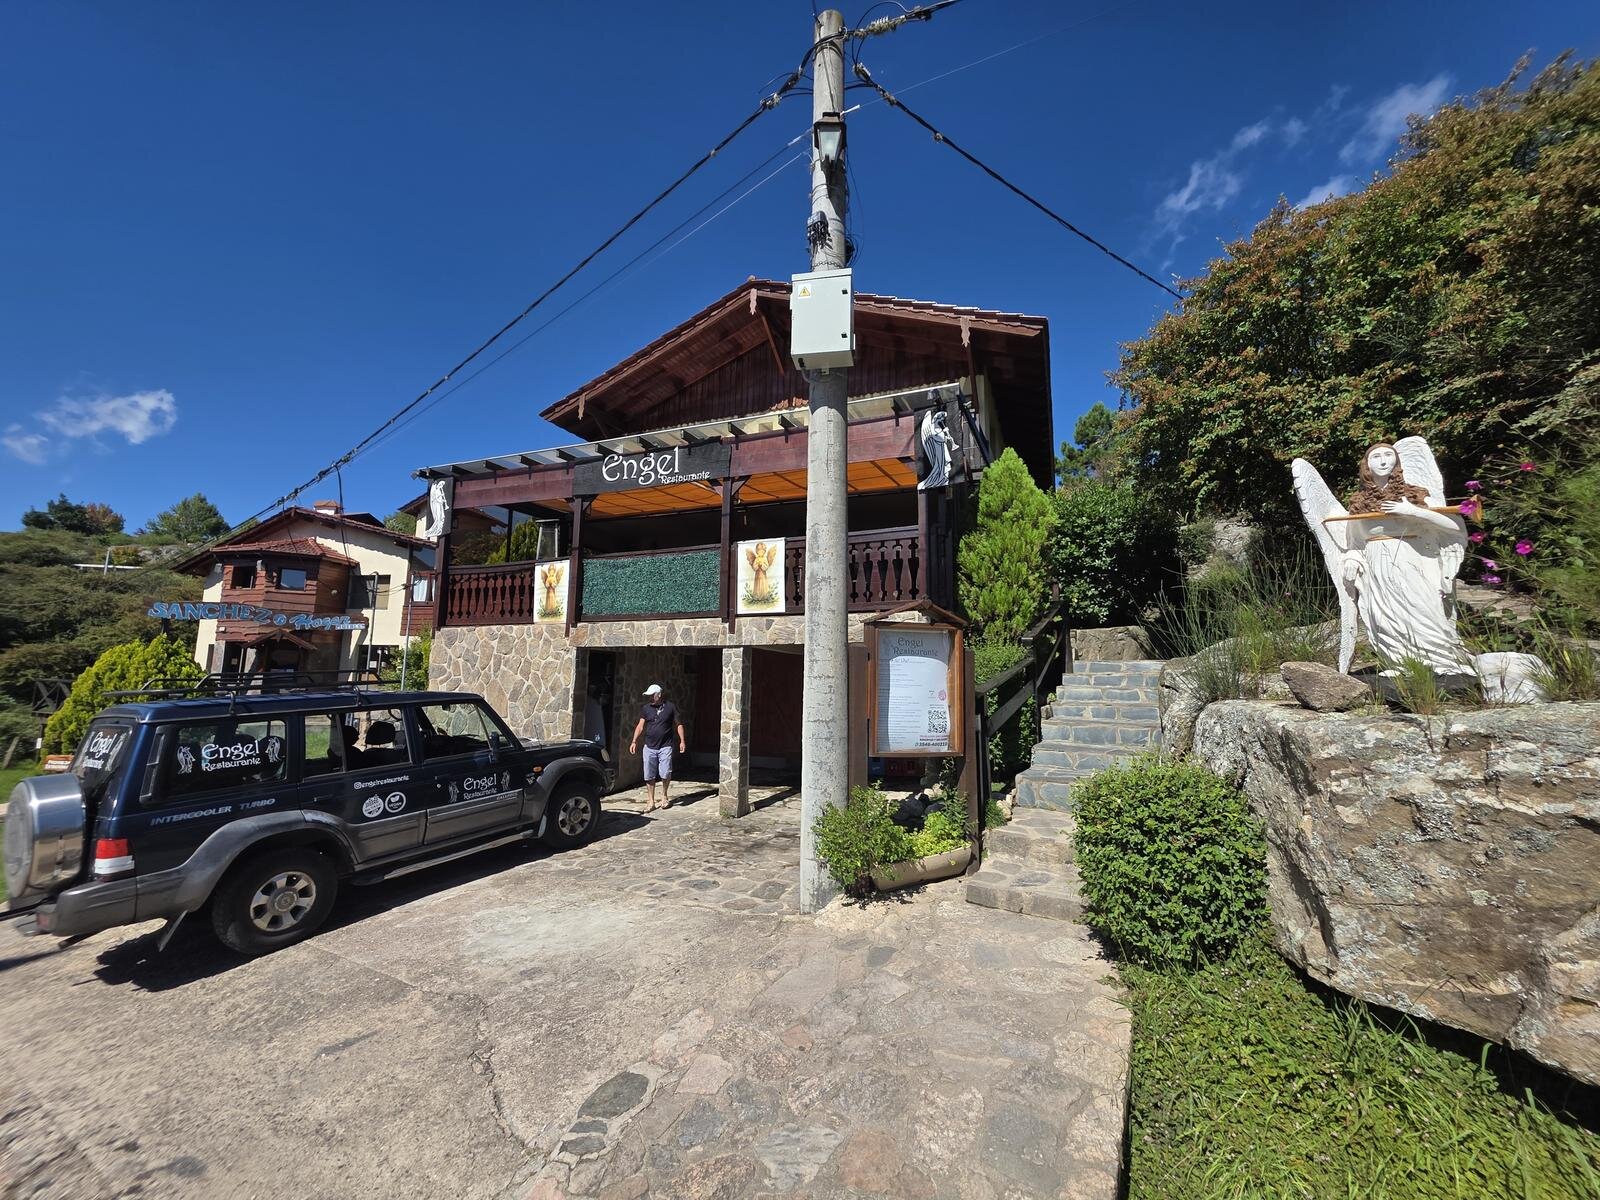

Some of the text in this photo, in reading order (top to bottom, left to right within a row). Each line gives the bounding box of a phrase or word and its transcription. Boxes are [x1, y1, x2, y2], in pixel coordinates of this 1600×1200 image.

[602, 446, 680, 485] Engel
[660, 471, 711, 484] Restaurante
[147, 601, 351, 630] SANCHEZ Hogar
[897, 637, 924, 648] Engel
[201, 740, 260, 760] Engel
[202, 756, 261, 772] Restaurante
[463, 773, 497, 791] Engel
[463, 787, 498, 800] Restaurante
[150, 798, 276, 826] INTERCOOLER TURBO
